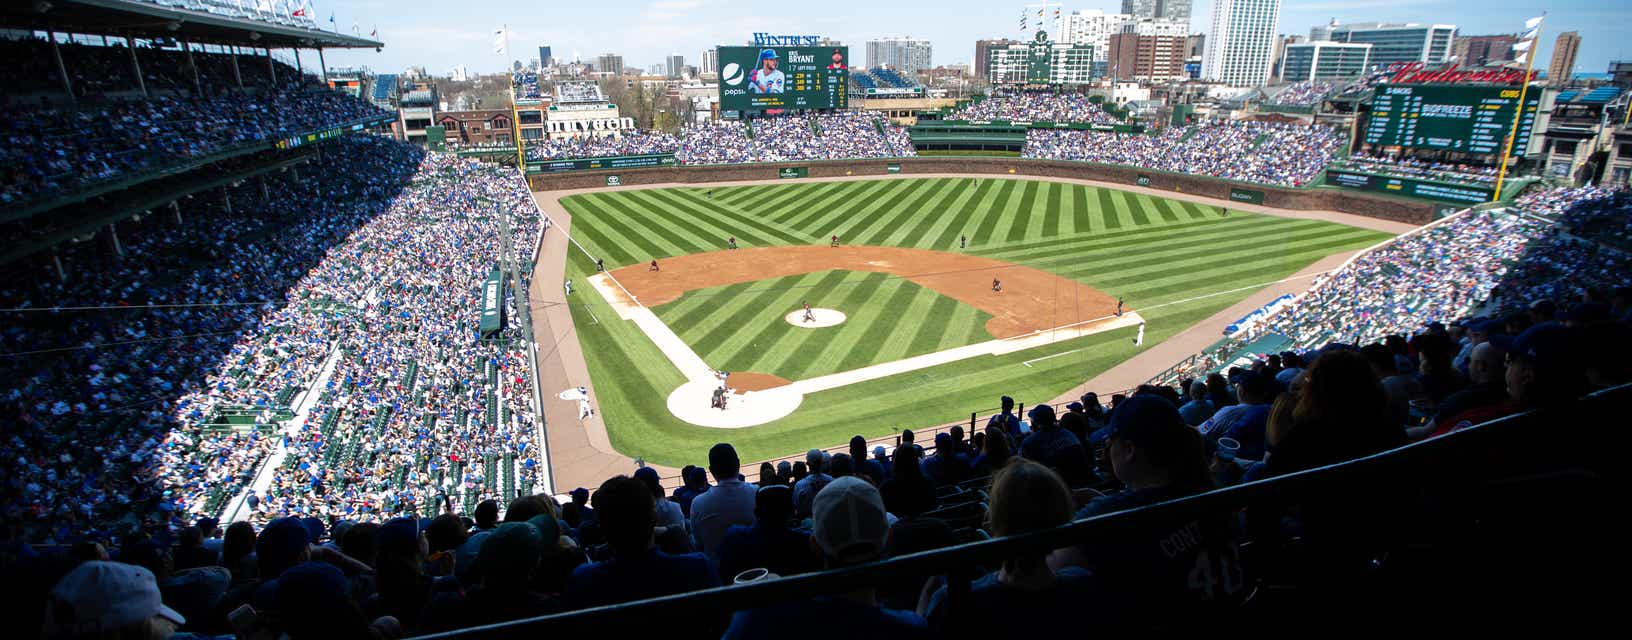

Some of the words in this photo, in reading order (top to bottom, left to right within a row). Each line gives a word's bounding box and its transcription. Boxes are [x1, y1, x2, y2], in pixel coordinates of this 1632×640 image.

[753, 32, 820, 46] WINTRUST
[788, 55, 815, 63] BRYANT
[1386, 62, 1539, 83] Budweiser
[1420, 104, 1473, 114] BIOFREEZE
[546, 117, 635, 132] nuveen
